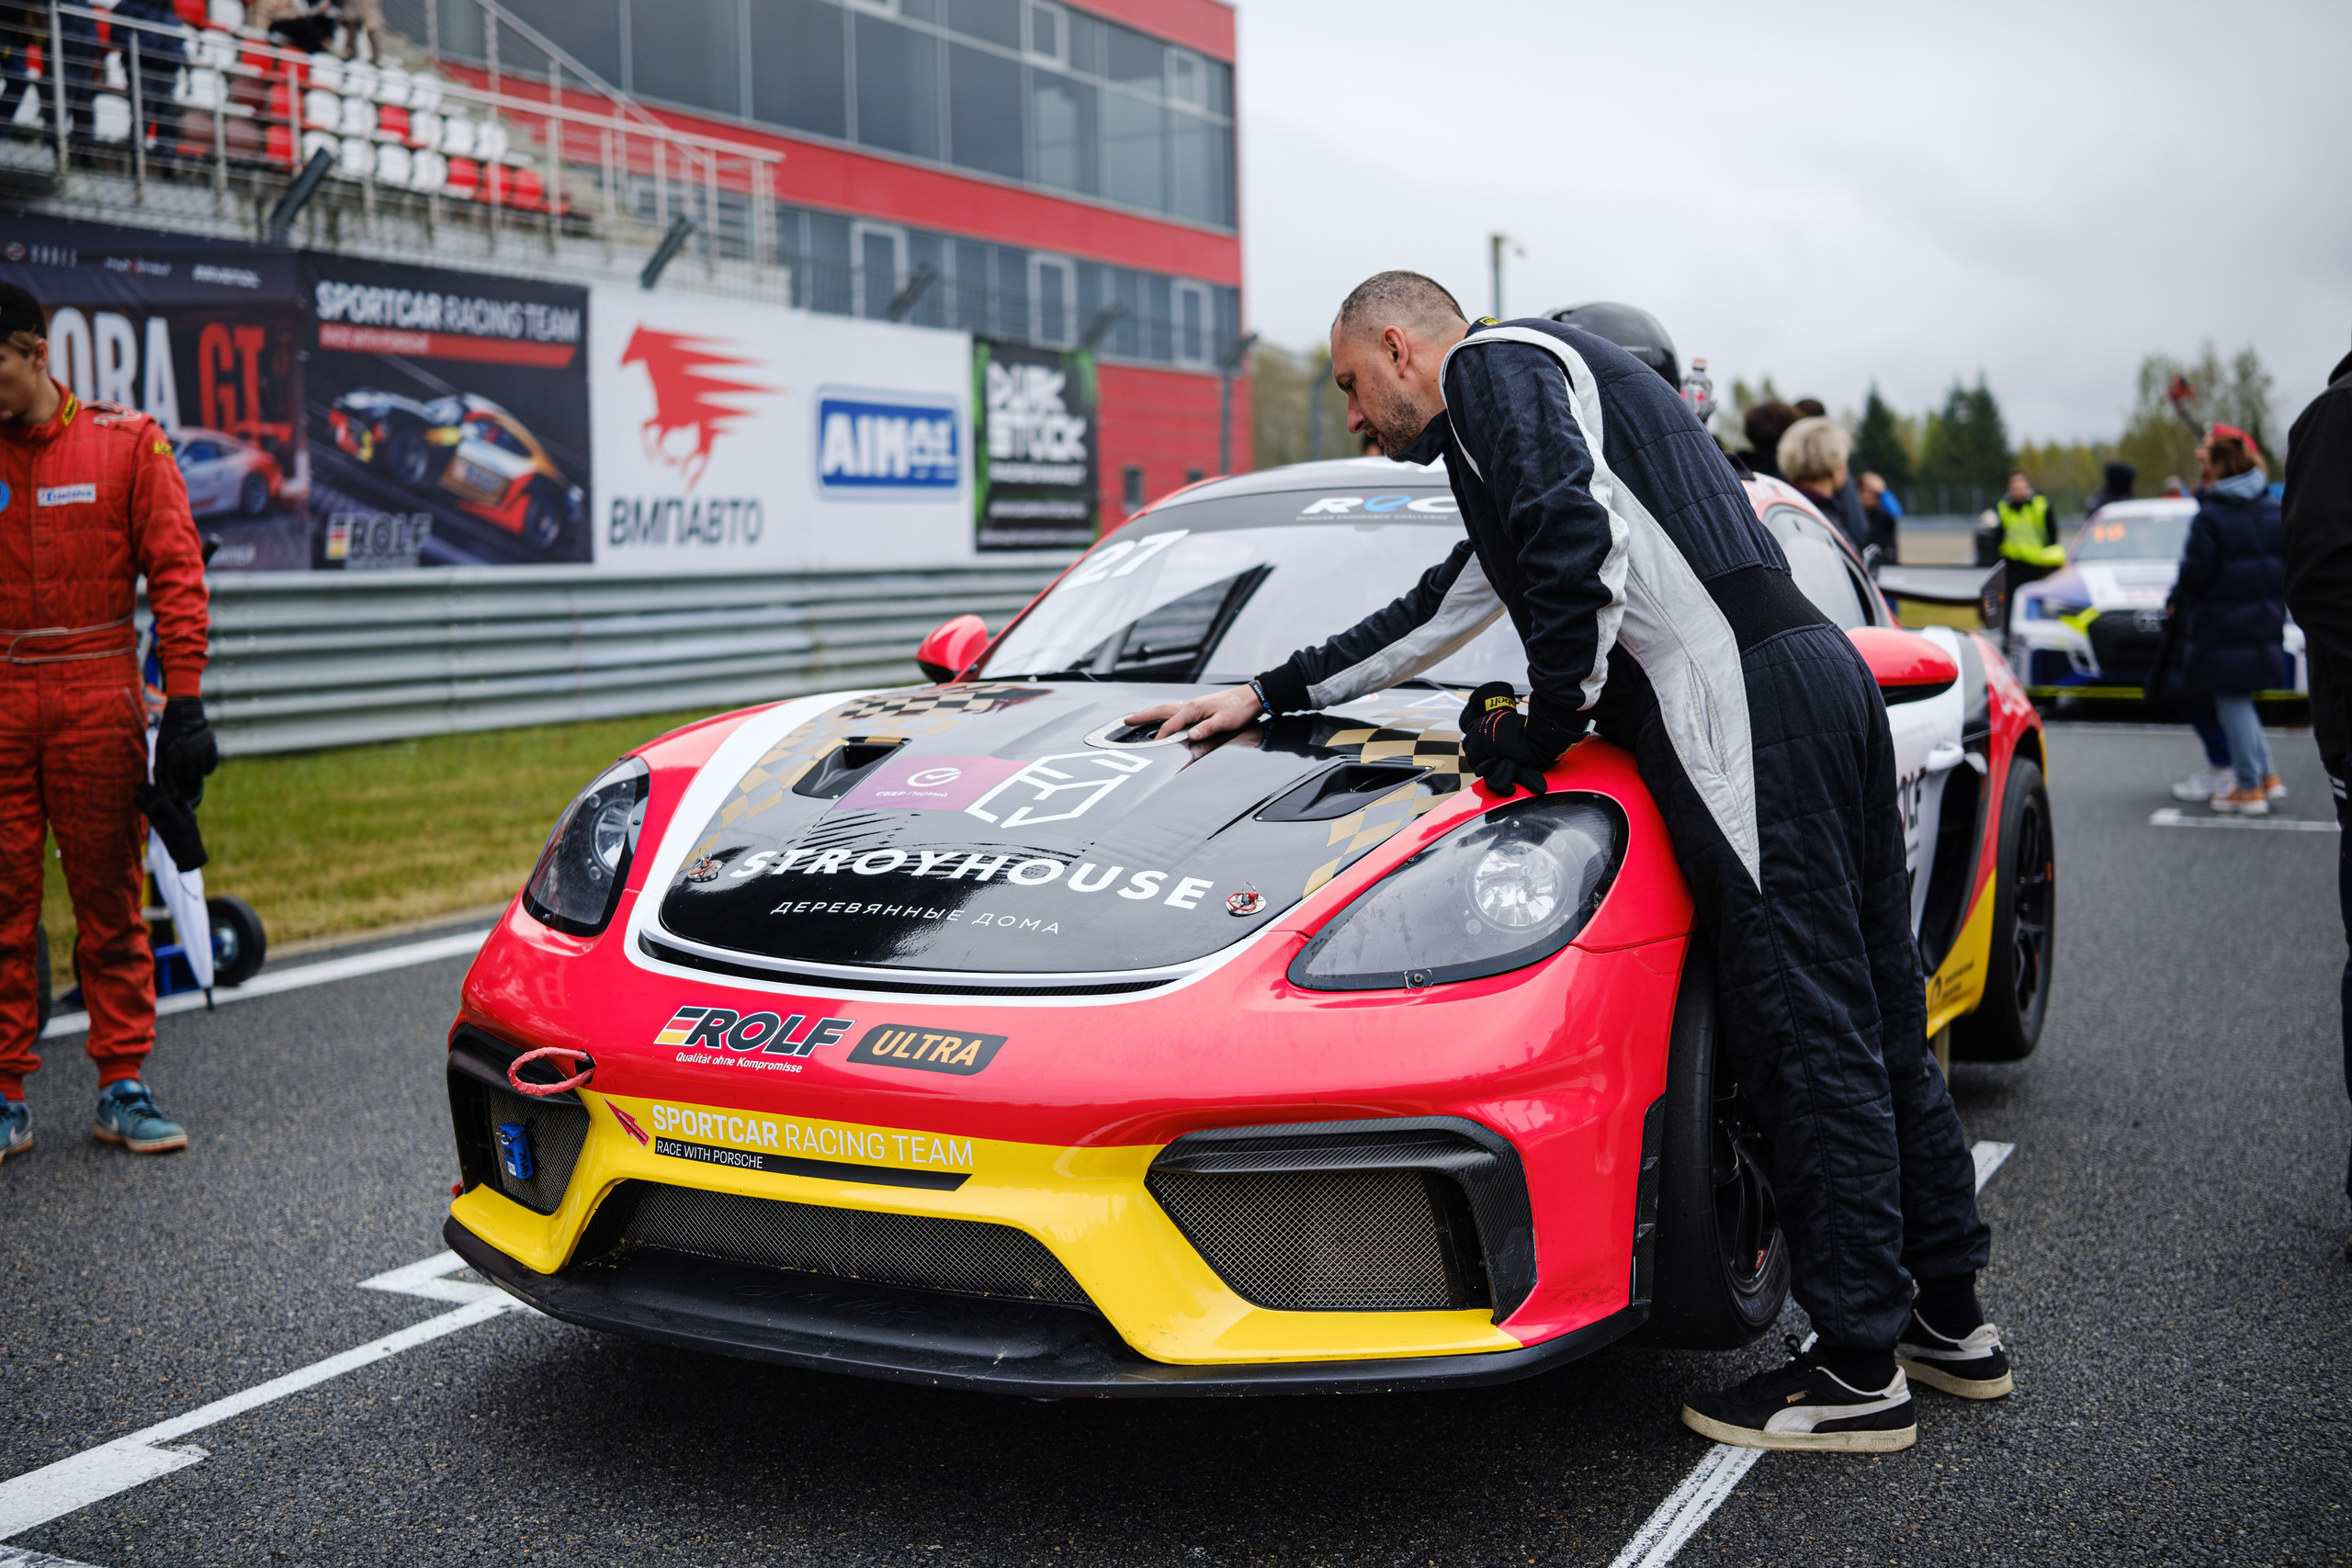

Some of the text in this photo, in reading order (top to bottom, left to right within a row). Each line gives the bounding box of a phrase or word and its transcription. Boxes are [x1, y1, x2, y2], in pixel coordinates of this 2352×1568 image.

[315, 280, 581, 343] SPORTCAR RACING TEAM
[48, 307, 266, 444] ORA GT
[609, 497, 763, 546] ВМПАВТО
[1057, 528, 1191, 593] 27
[729, 847, 1216, 910] STROYHOUSE
[770, 899, 1061, 935] ДЕРЕВЯННЫЕ ДОМА
[683, 1006, 857, 1058] ROLF
[871, 1029, 984, 1066] ULTRA
[712, 1056, 735, 1066] ohne
[737, 1057, 803, 1074] Kompromisse
[652, 1104, 973, 1168] SPORTCAR RACING TEAM
[657, 1140, 763, 1169] RACE WITH PORSCHE
